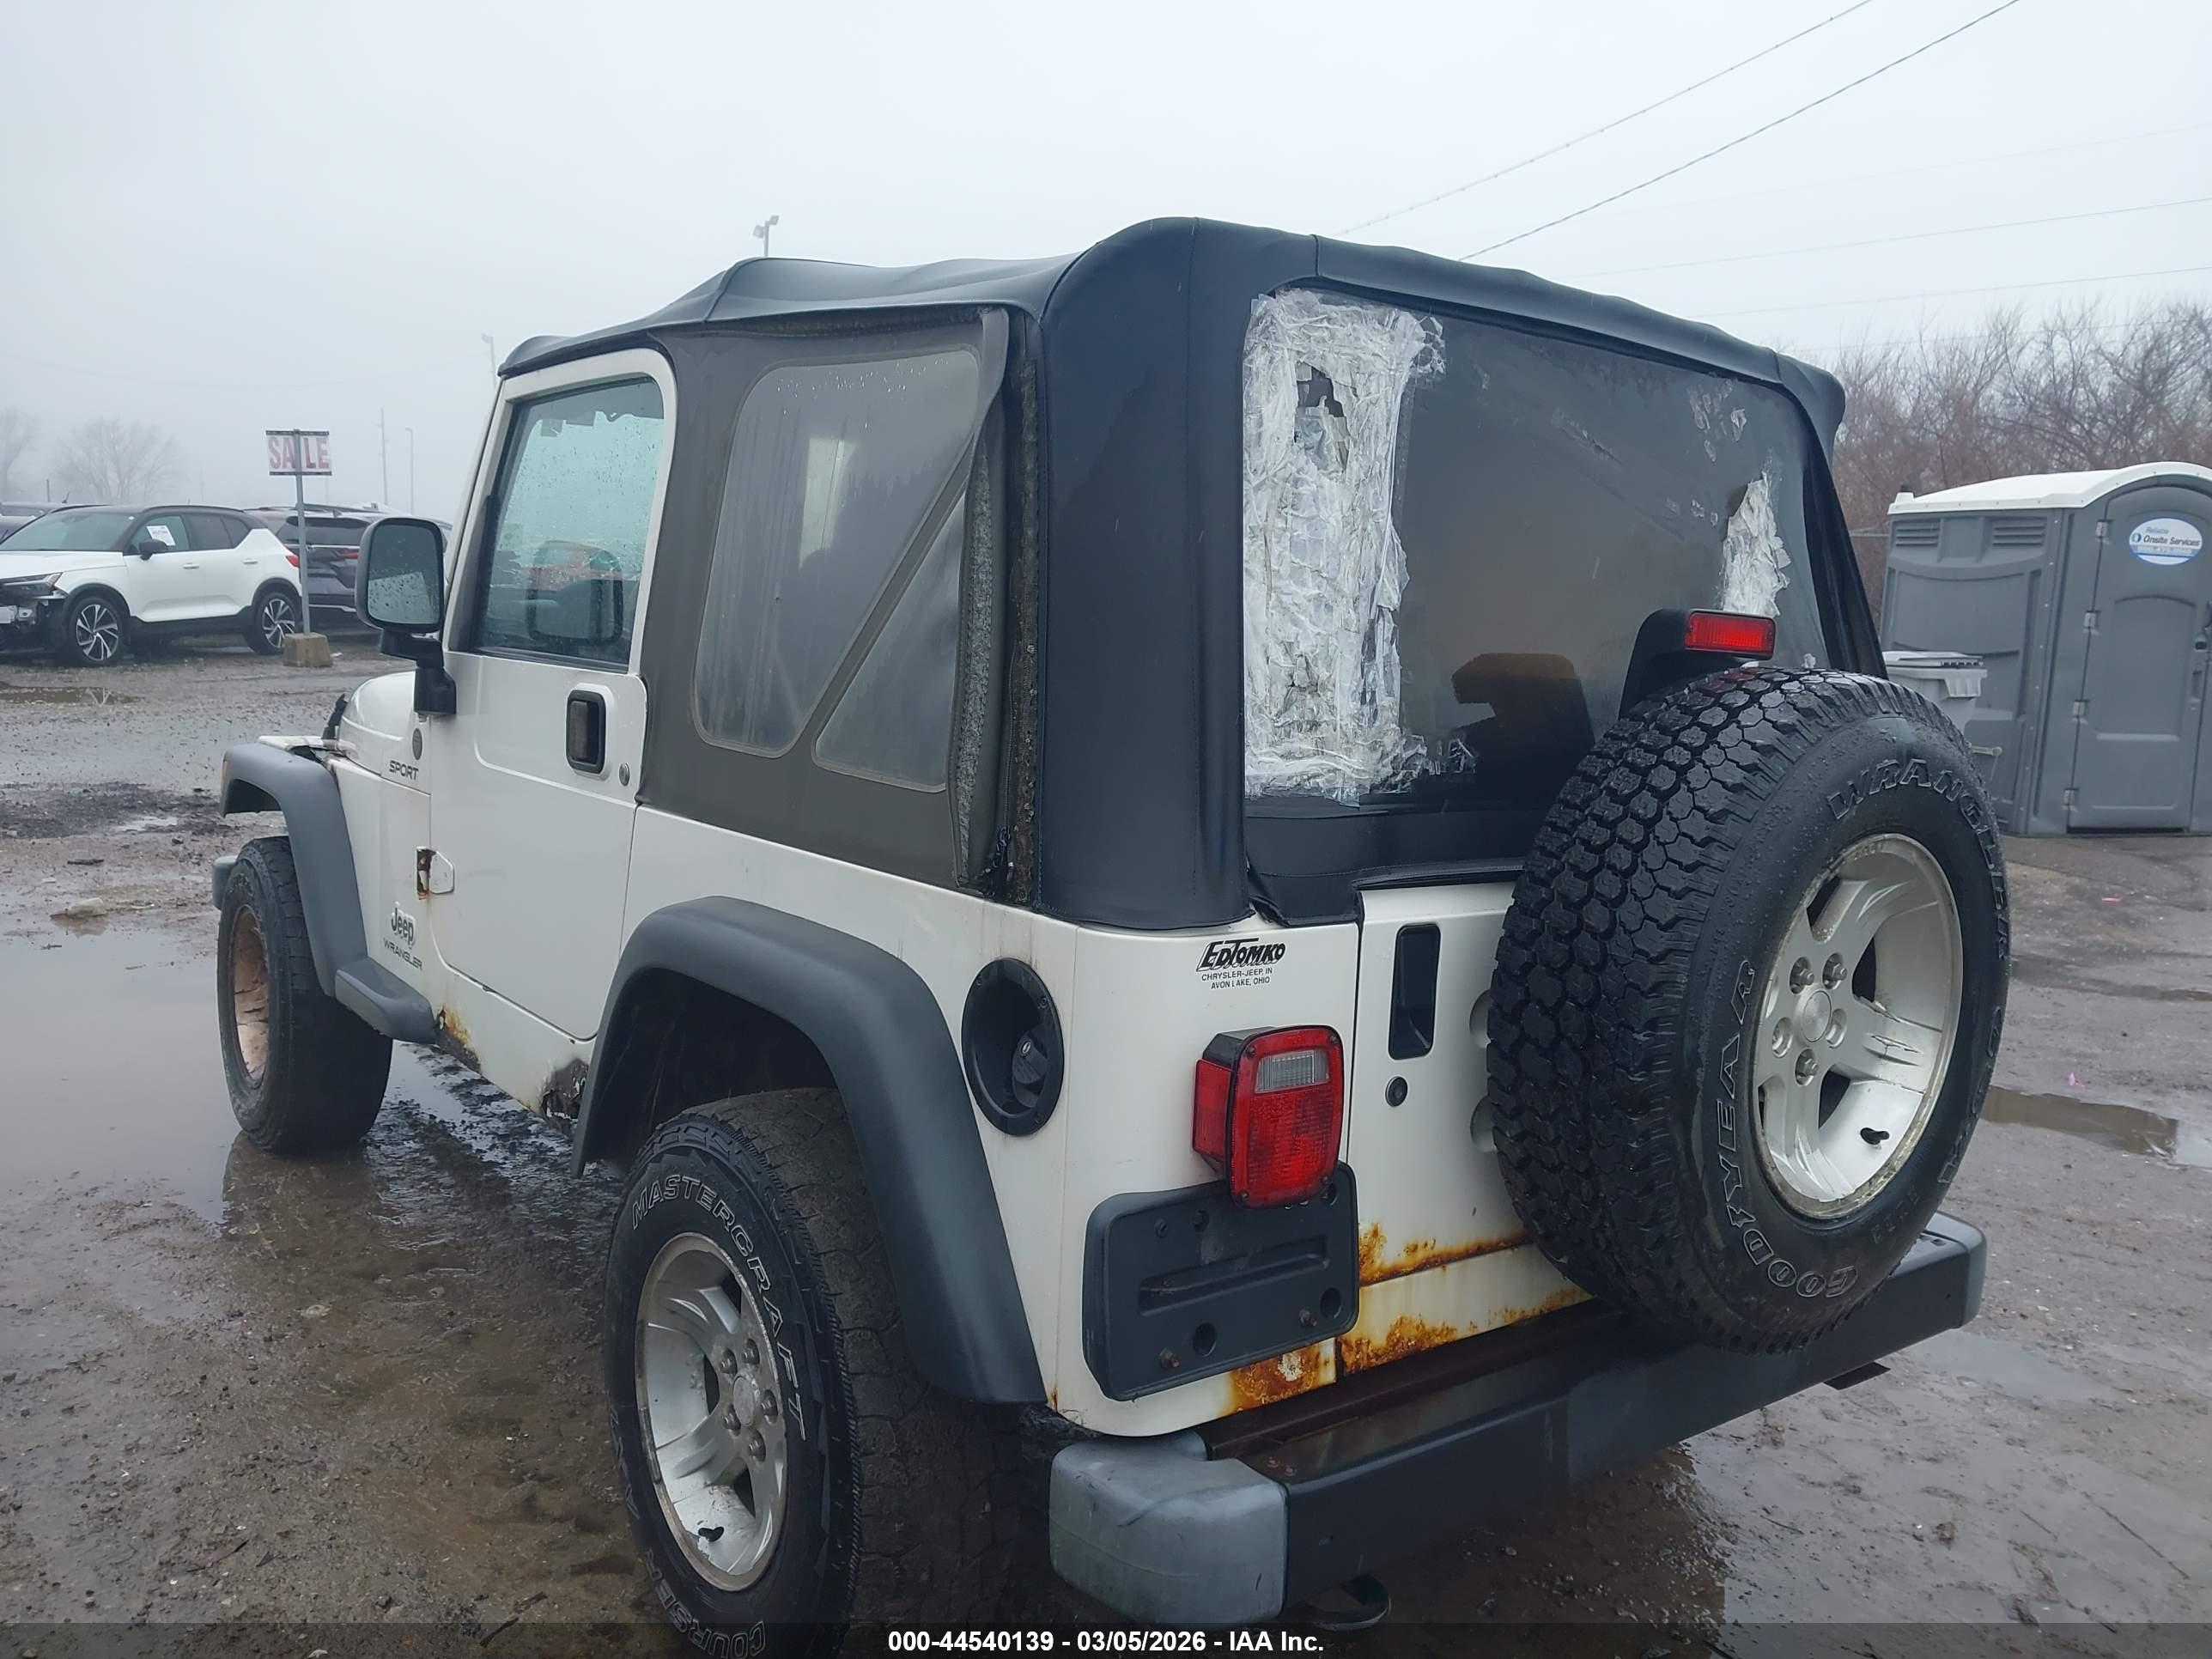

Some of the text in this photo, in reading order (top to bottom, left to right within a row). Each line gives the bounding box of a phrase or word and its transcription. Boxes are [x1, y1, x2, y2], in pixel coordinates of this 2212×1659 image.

[268, 436, 330, 469] SALE
[2143, 534, 2201, 546] Onsite Services
[389, 760, 419, 781] SPORT
[1827, 758, 2009, 961] WRANGLER
[391, 905, 416, 947] Jeep
[383, 938, 423, 971] WRANGLER
[1211, 981, 1231, 990] AVON
[1253, 976, 1270, 985] OHIO
[1717, 960, 1858, 1297] GOODYEAR
[632, 1175, 806, 1442] MASTERCRAFT
[644, 1548, 767, 1659] COURSER
